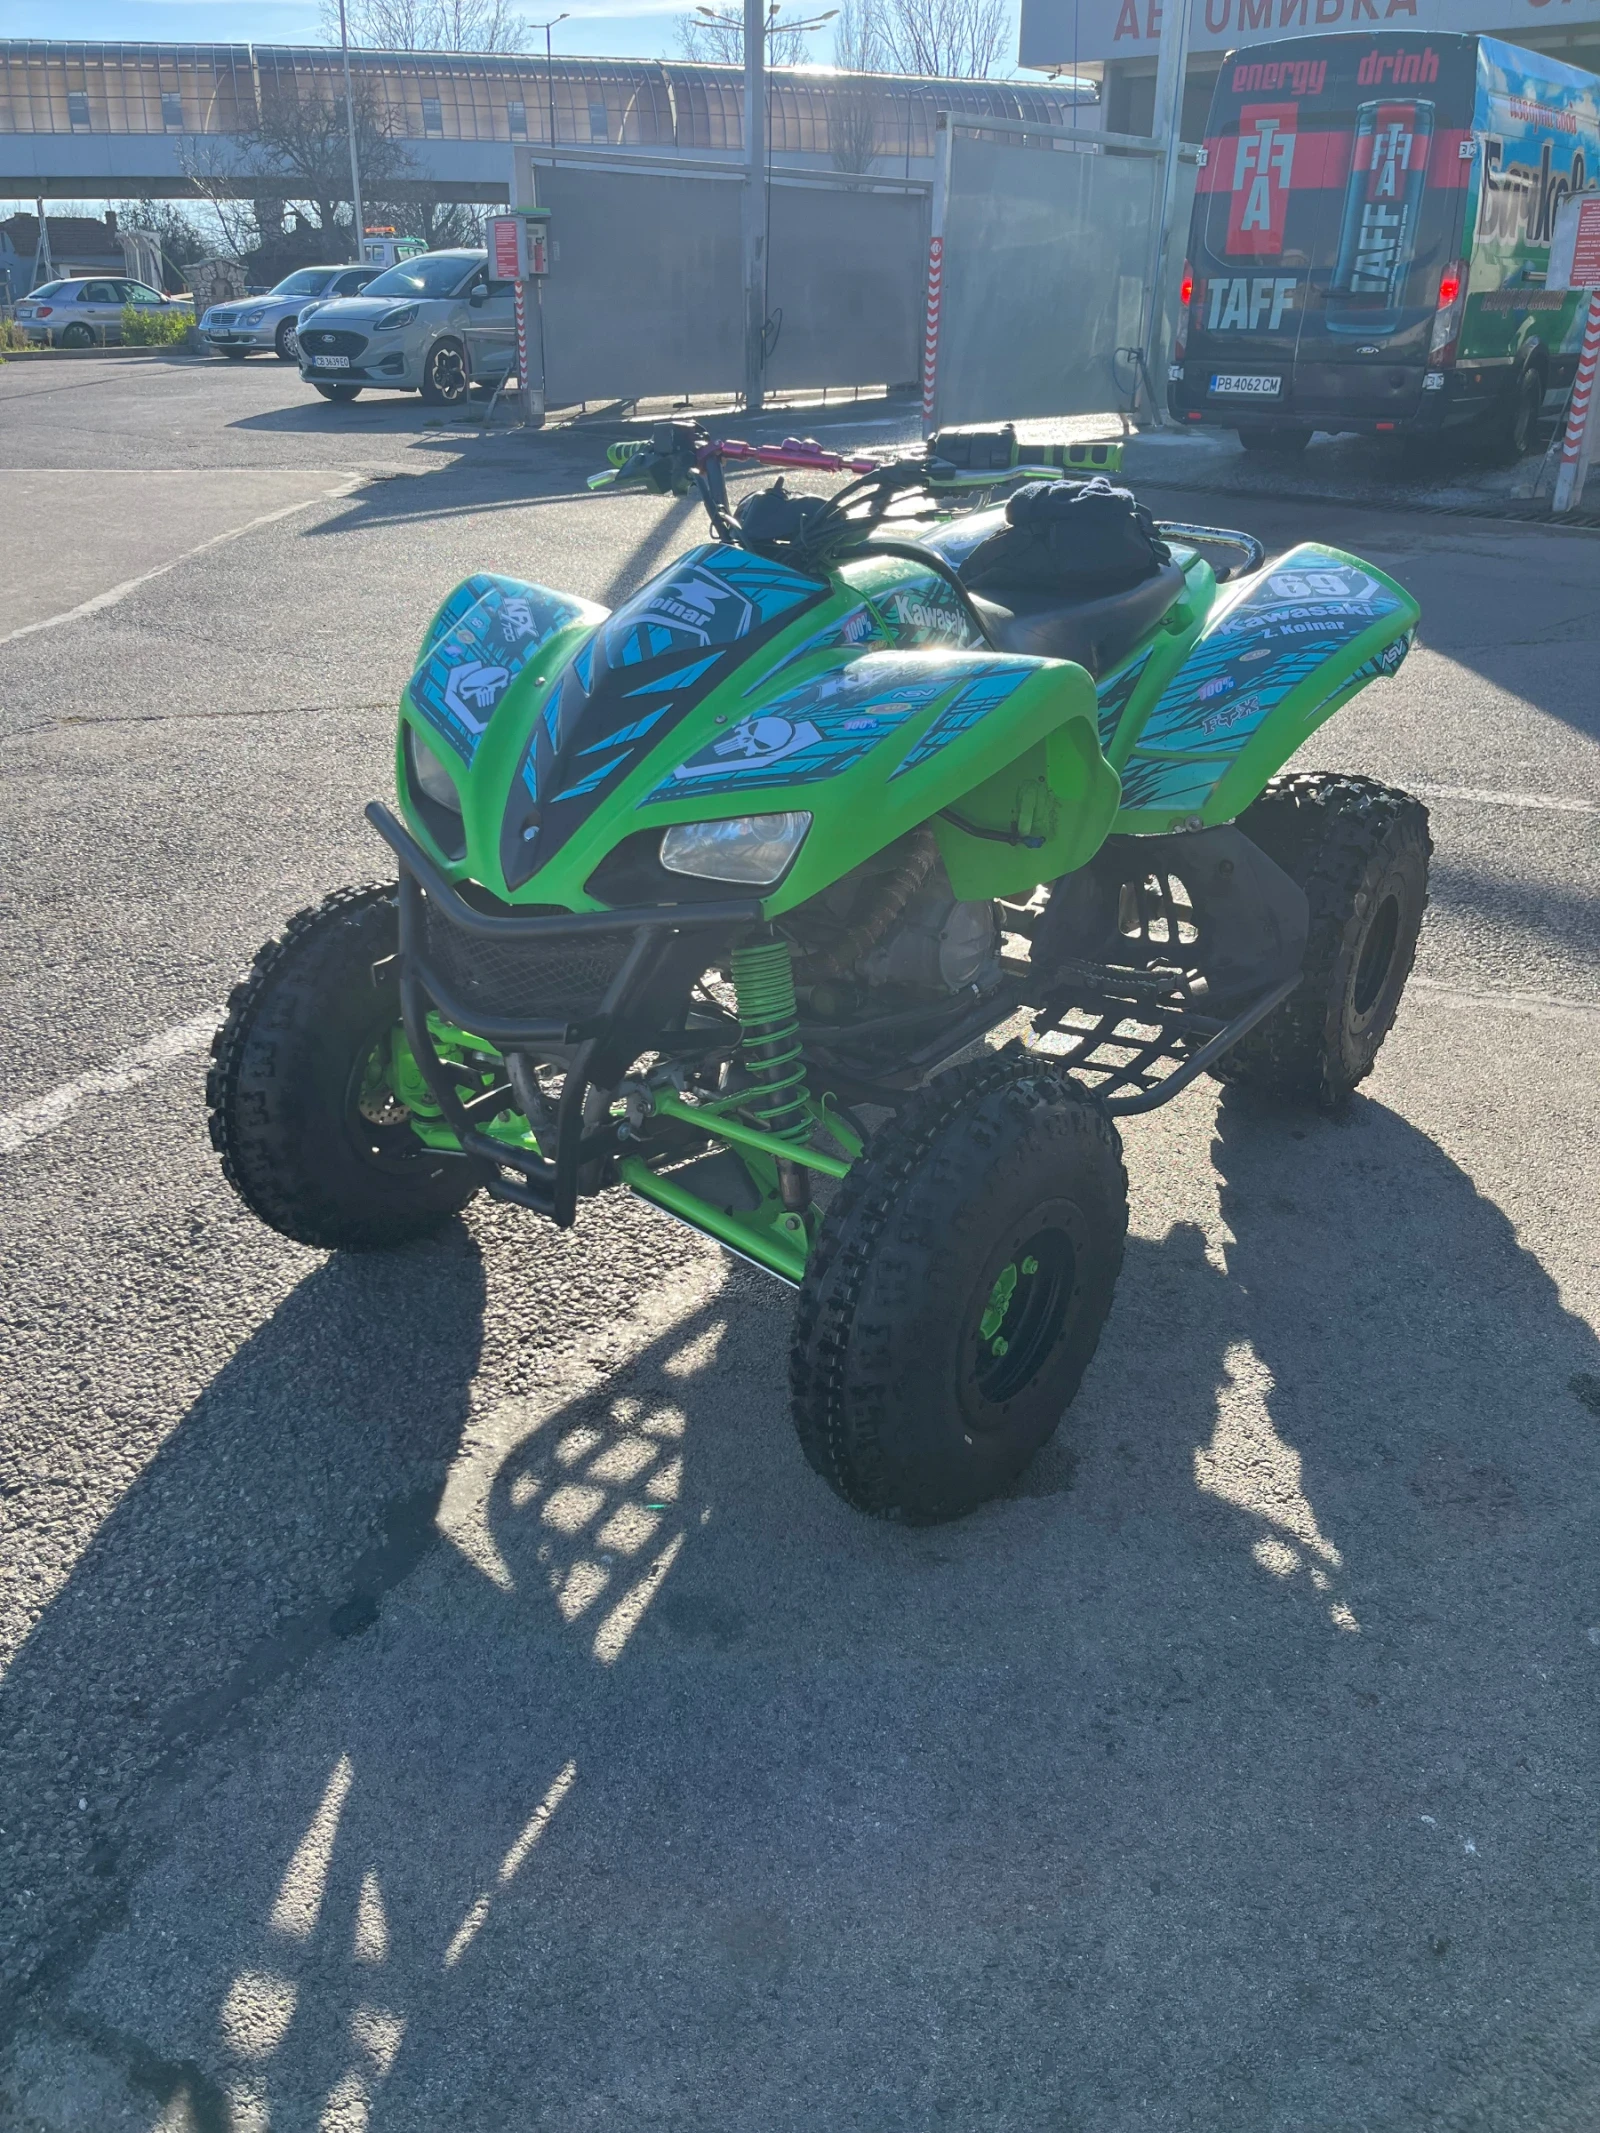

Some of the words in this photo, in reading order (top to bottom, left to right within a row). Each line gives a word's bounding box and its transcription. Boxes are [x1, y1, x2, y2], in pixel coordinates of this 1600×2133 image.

[1113, 0, 1418, 41] АВОМИВ
[1232, 60, 1327, 95] energy
[1357, 48, 1439, 85] drink
[1350, 204, 1399, 292] TAFF
[1207, 278, 1297, 330] TAFF
[1268, 574, 1350, 597] 69
[846, 615, 872, 641] 100%
[895, 595, 968, 638] Kawasaki
[1218, 603, 1374, 636] Kawasaki
[1283, 621, 1345, 635] Koinar
[501, 622, 516, 643] 700
[1200, 676, 1234, 700] 100%
[847, 719, 877, 730] 100%
